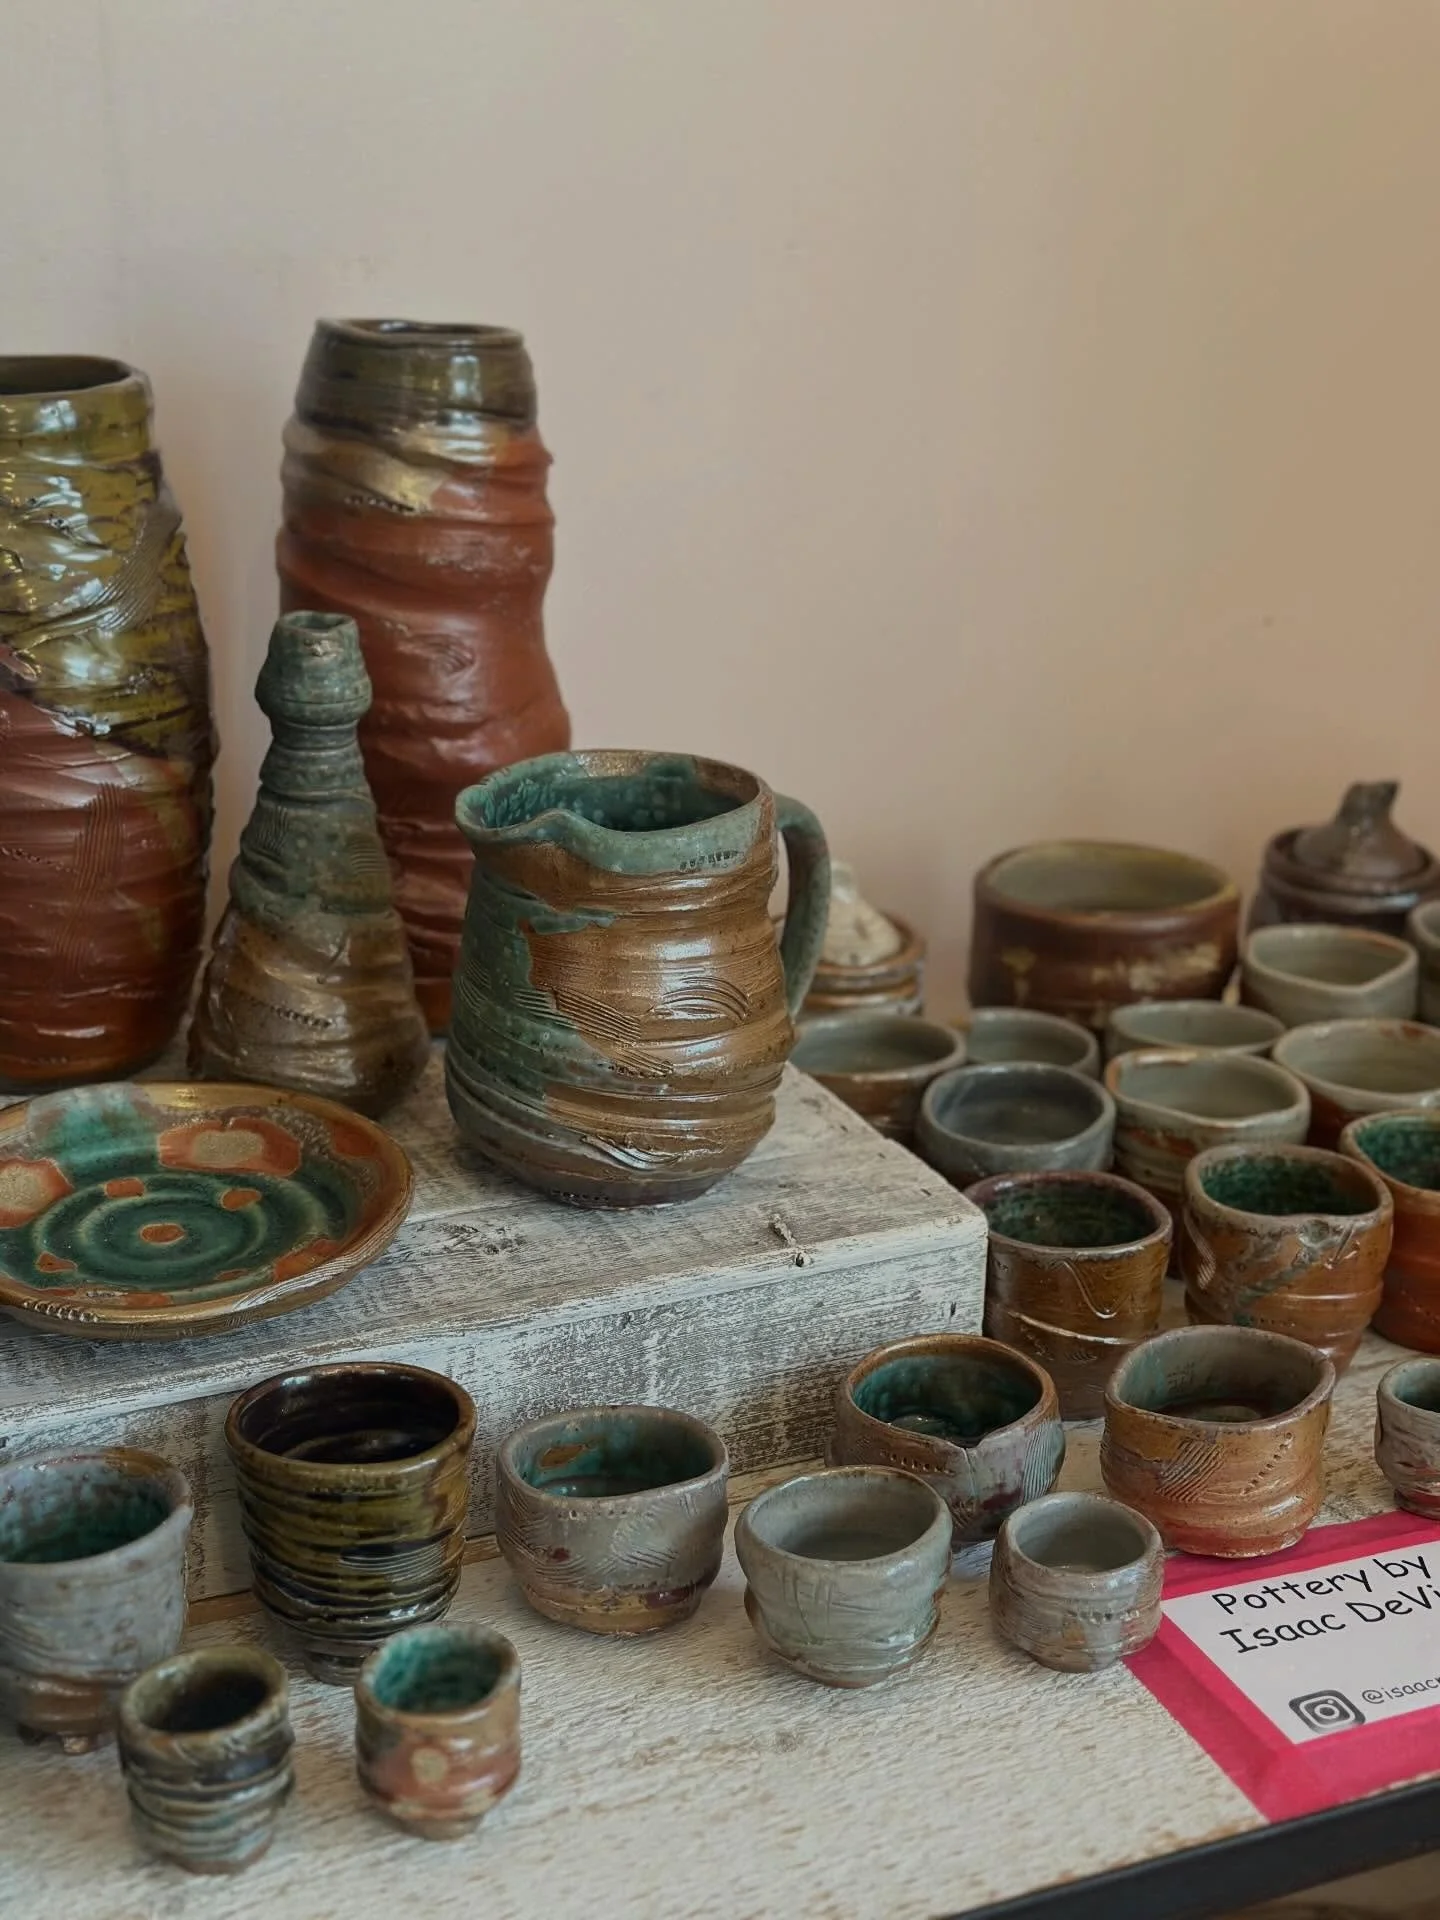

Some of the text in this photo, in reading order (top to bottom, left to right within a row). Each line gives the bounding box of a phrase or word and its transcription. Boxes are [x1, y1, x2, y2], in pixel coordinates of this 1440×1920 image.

[1211, 1555, 1432, 1615] Pottery by
[1219, 1611, 1346, 1654] Isaac
[1361, 1677, 1440, 1704] @isaac
